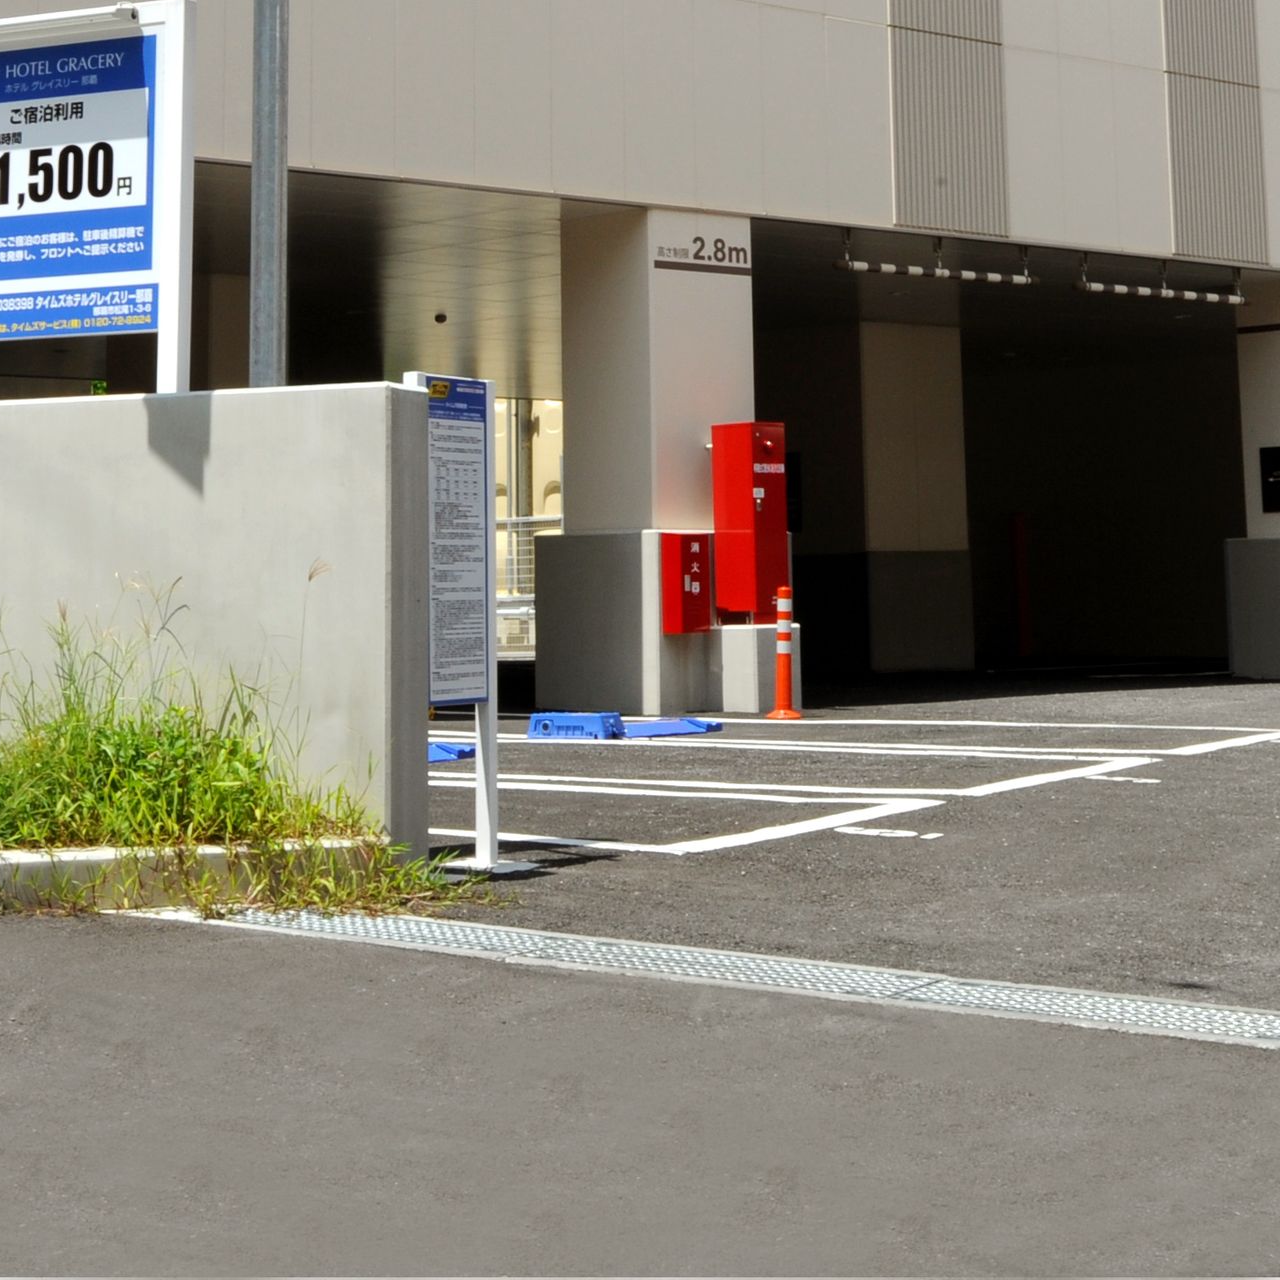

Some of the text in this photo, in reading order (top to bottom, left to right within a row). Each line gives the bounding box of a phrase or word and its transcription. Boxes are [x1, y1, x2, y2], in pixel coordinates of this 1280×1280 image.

[5, 52, 124, 79] HOTEL GRACERY
[5, 82, 28, 93] ホテル
[31, 78, 80, 92] グレイスリー
[9, 101, 84, 125] ご宿泊利用
[692, 236, 748, 264] 2.8m
